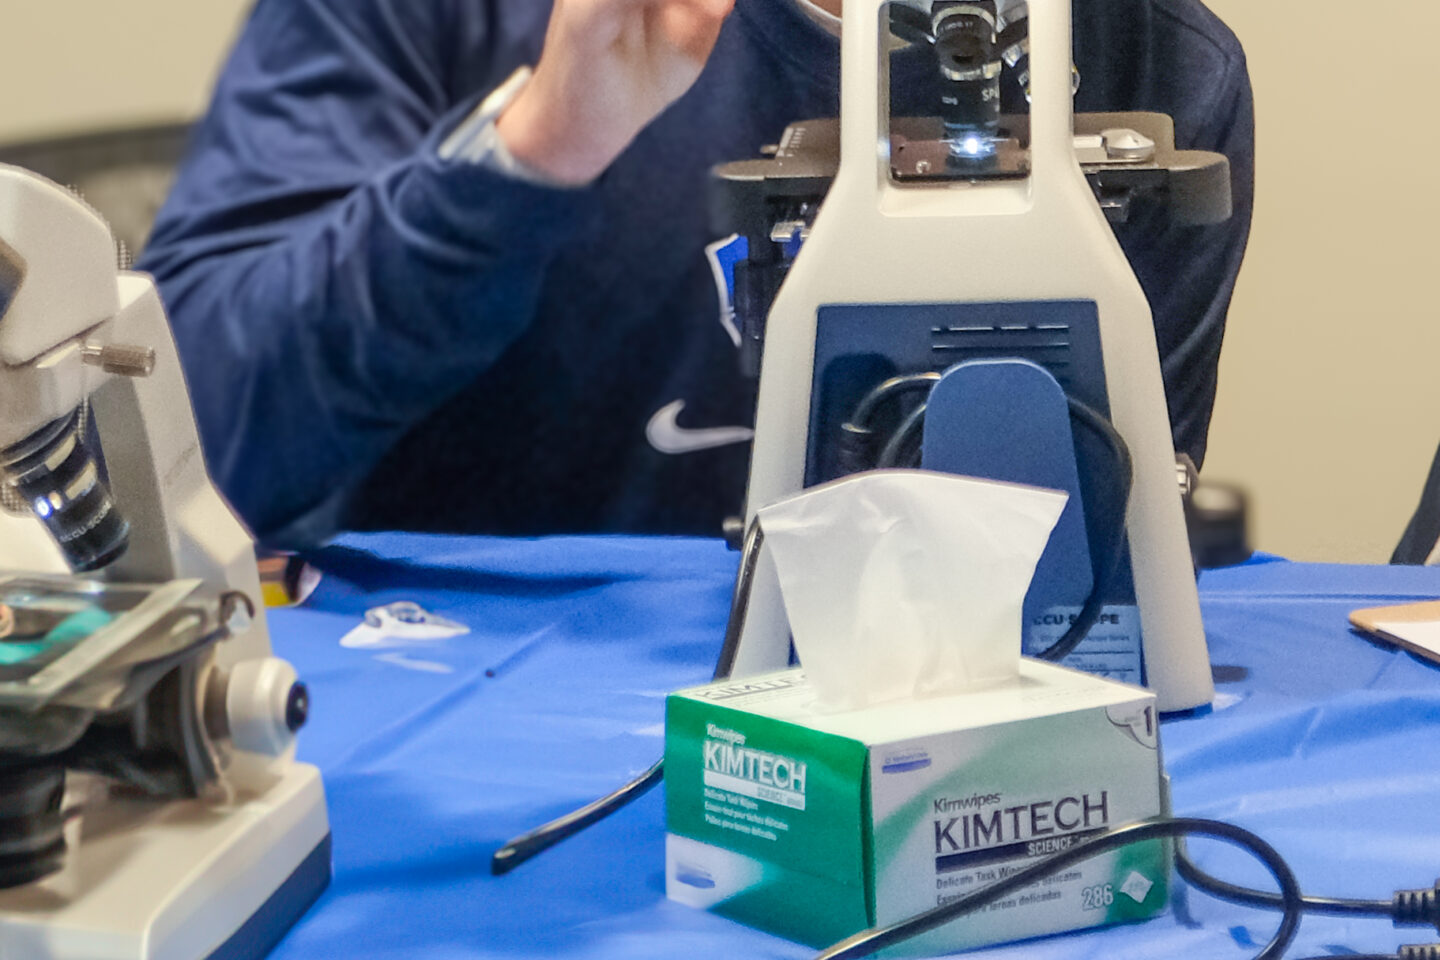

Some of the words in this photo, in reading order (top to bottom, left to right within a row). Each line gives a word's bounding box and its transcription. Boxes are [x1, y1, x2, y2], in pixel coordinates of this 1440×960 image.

[704, 740, 807, 793] KIMTECH
[934, 792, 1002, 815] Kimwipes
[934, 791, 1109, 853] KIMTECH
[1081, 882, 1114, 912] 286
